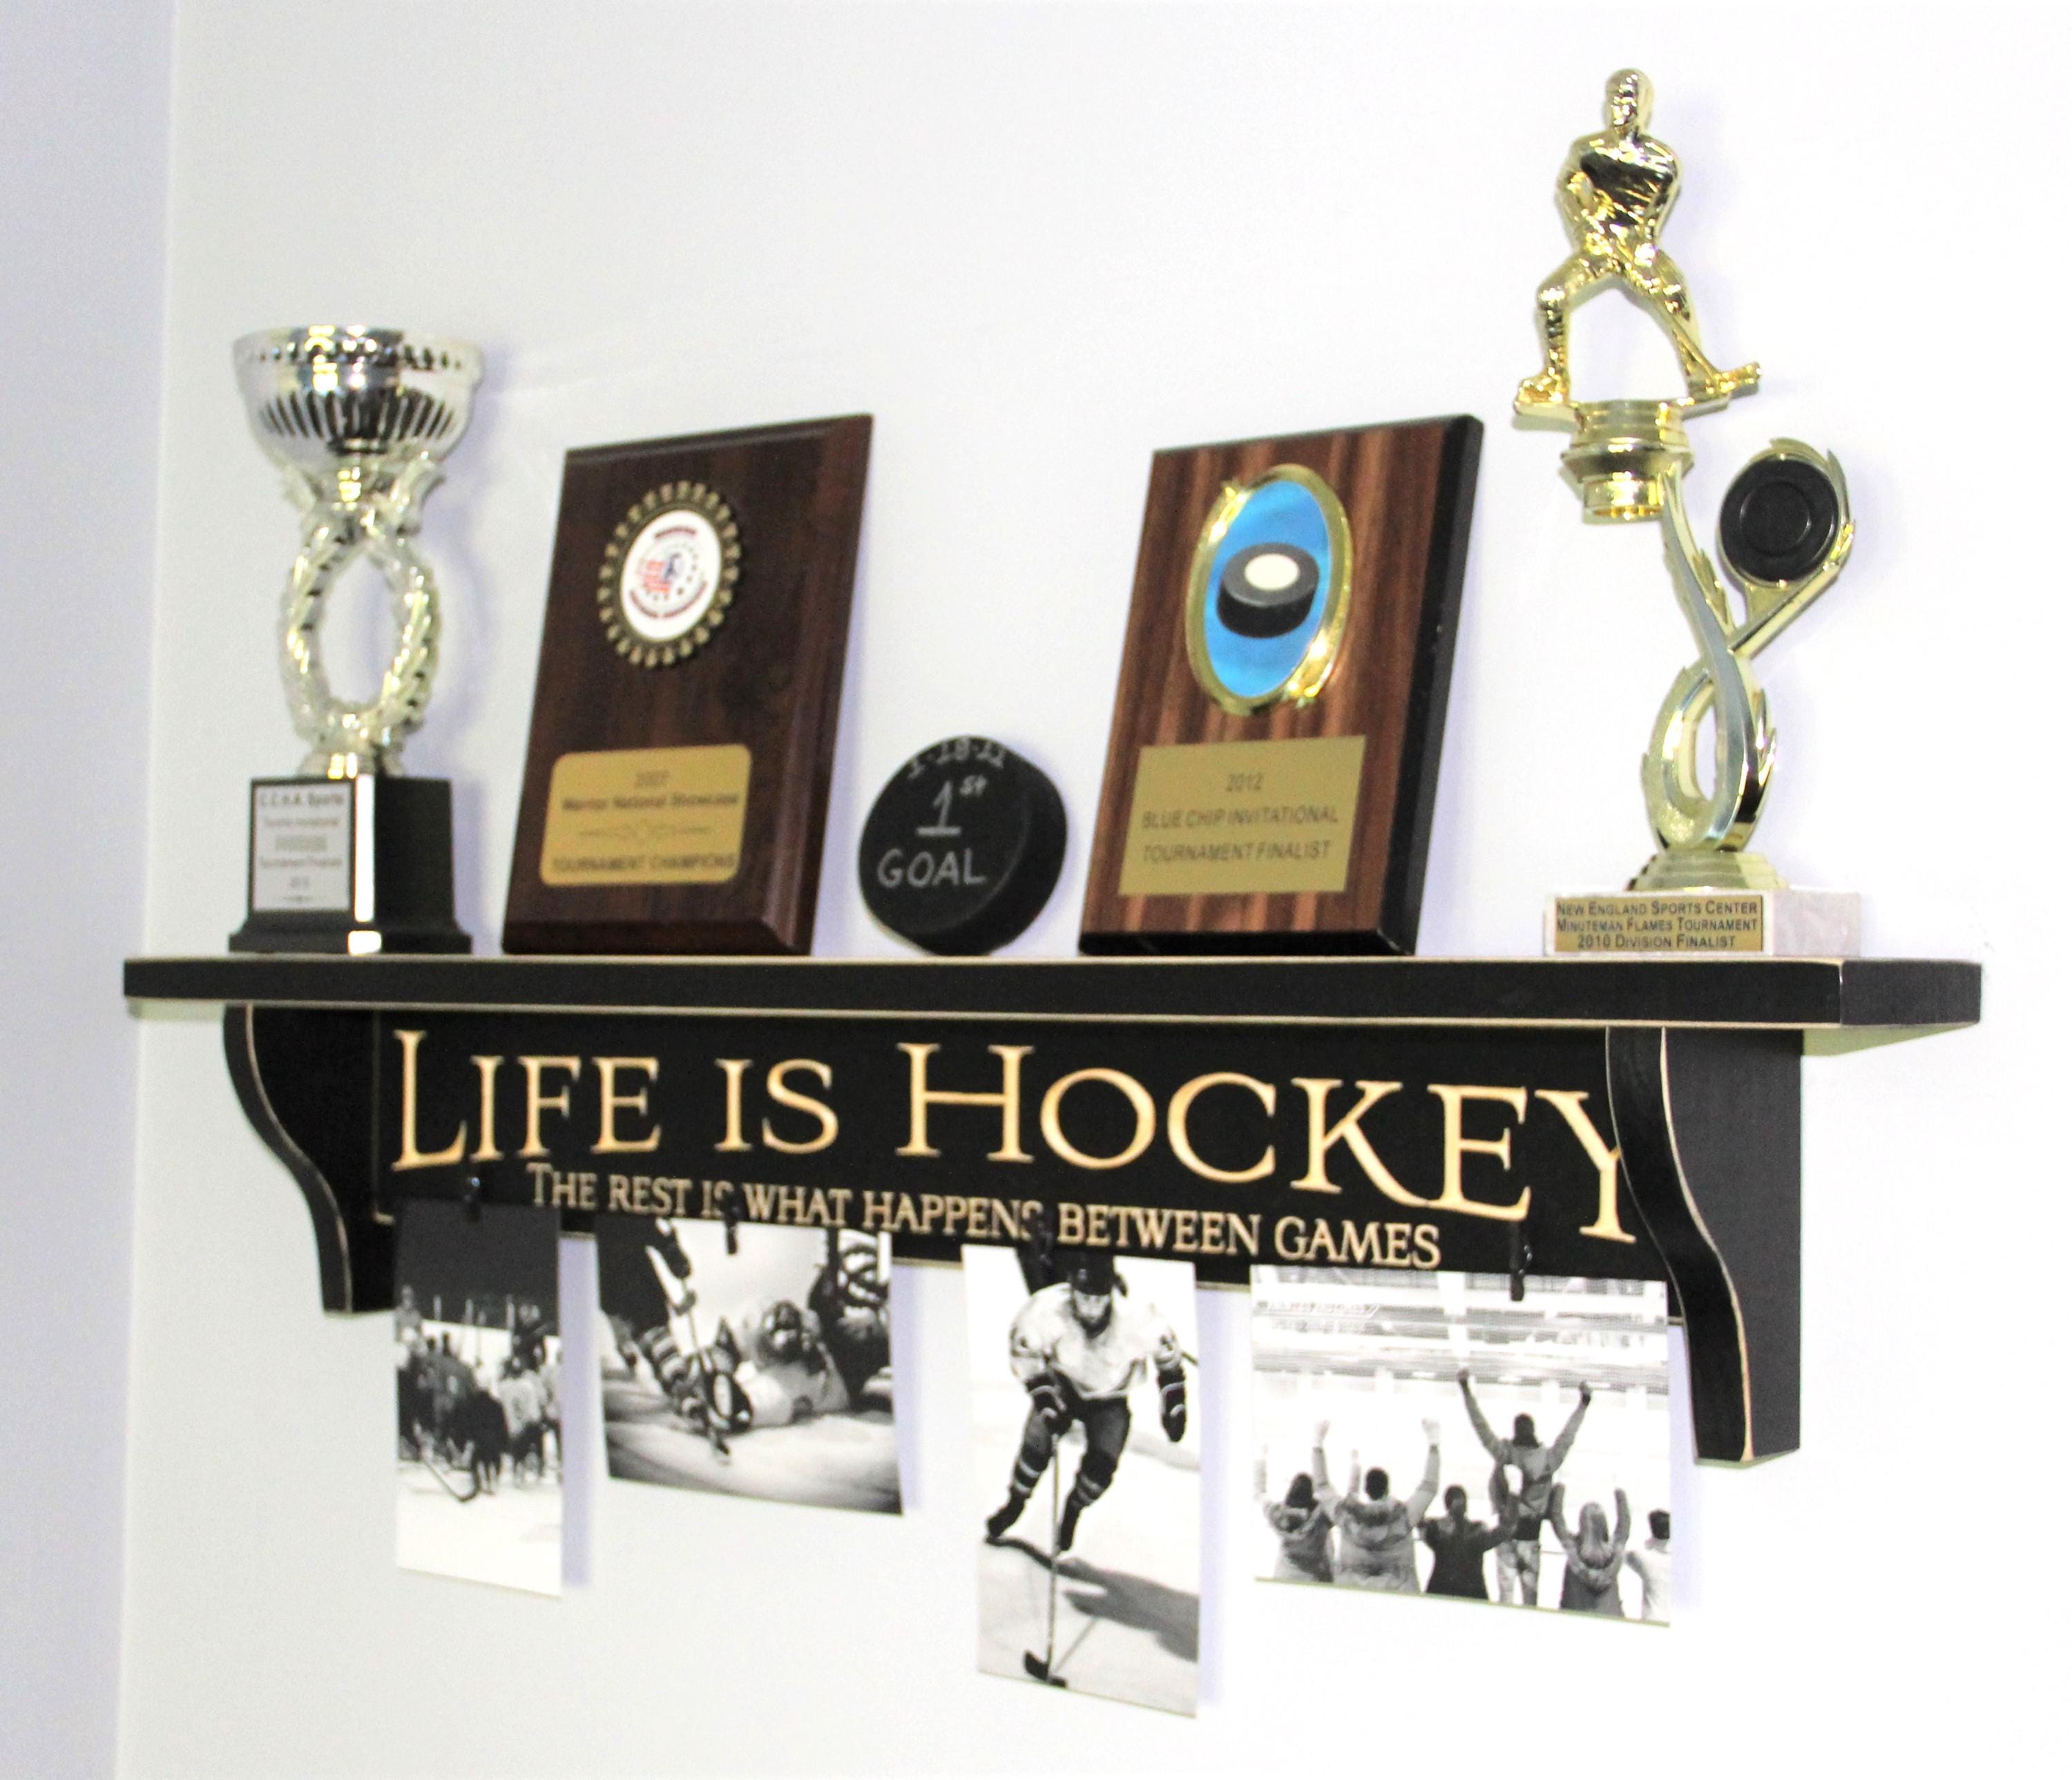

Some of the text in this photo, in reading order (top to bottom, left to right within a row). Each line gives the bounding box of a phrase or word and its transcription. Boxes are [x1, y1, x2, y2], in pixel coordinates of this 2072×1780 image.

[1225, 772, 1265, 793] 2012
[1142, 805, 1339, 830] BLUE CHIP INVITATIONAL
[1143, 839, 1332, 865] TOURNAMENT FINALIST
[877, 847, 987, 889] GOAL
[1557, 900, 1758, 915] NEW ENGLAND SPORTS CENTER
[1557, 917, 1758, 932] MINUTEMAN FLAMES TOURNAMENT
[1577, 934, 1736, 949] 2010 DIVISION FINALIST
[392, 1030, 1636, 1243] LIFE IS HOCKEY
[526, 1162, 597, 1209] THE
[608, 1174, 691, 1217] REST
[742, 1181, 853, 1228] WHAT
[1057, 1202, 1260, 1257] BETWEEN
[1274, 1216, 1441, 1271] GAMES
